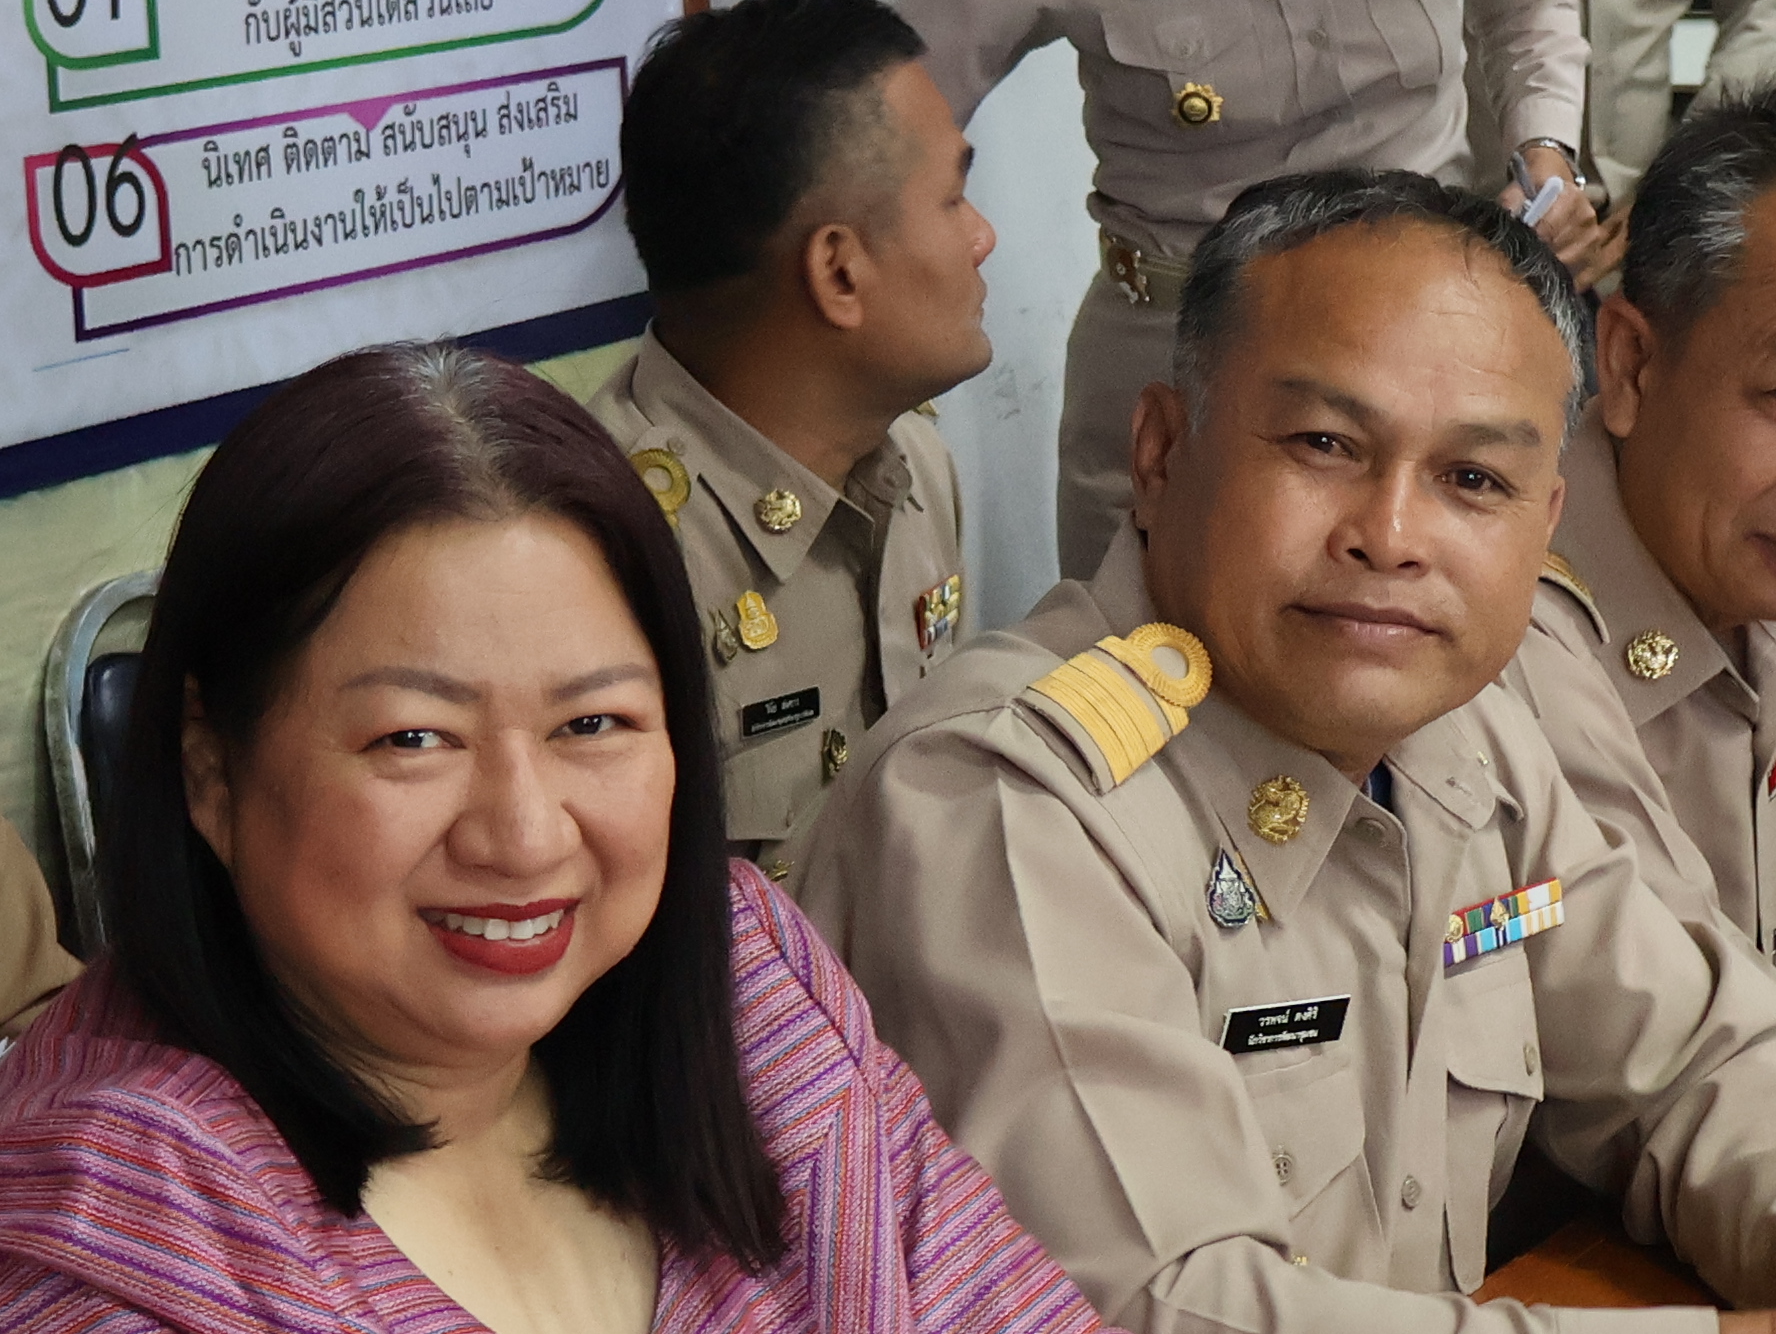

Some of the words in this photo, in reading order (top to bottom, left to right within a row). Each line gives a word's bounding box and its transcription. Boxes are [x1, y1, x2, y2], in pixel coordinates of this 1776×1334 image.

[52, 132, 148, 247] 06
[202, 140, 273, 190] นิเทศ
[282, 126, 372, 172] ติดตาม
[380, 102, 489, 159] สนับสนุน
[496, 81, 579, 136] ส่งเสริม
[174, 156, 611, 276] การดำเนินงานให้เป็นไปตามเป้าหมาย
